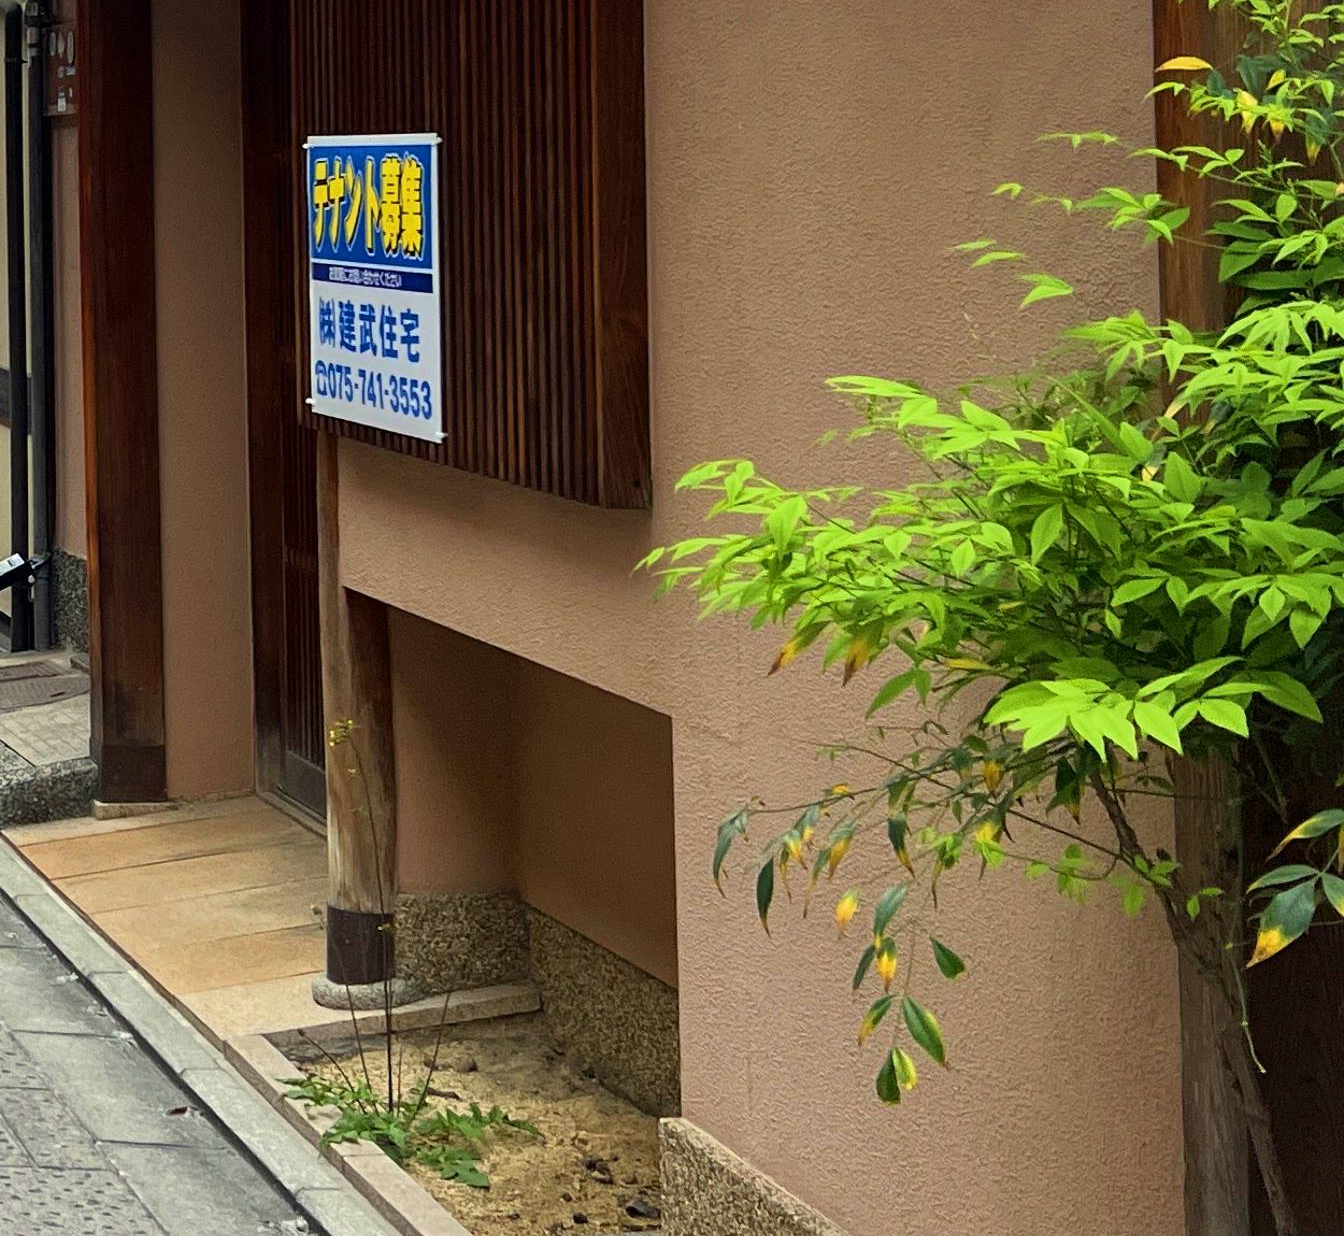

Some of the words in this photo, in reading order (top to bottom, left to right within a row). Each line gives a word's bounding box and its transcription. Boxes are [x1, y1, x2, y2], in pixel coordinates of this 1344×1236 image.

[313, 152, 426, 261] テナント募集
